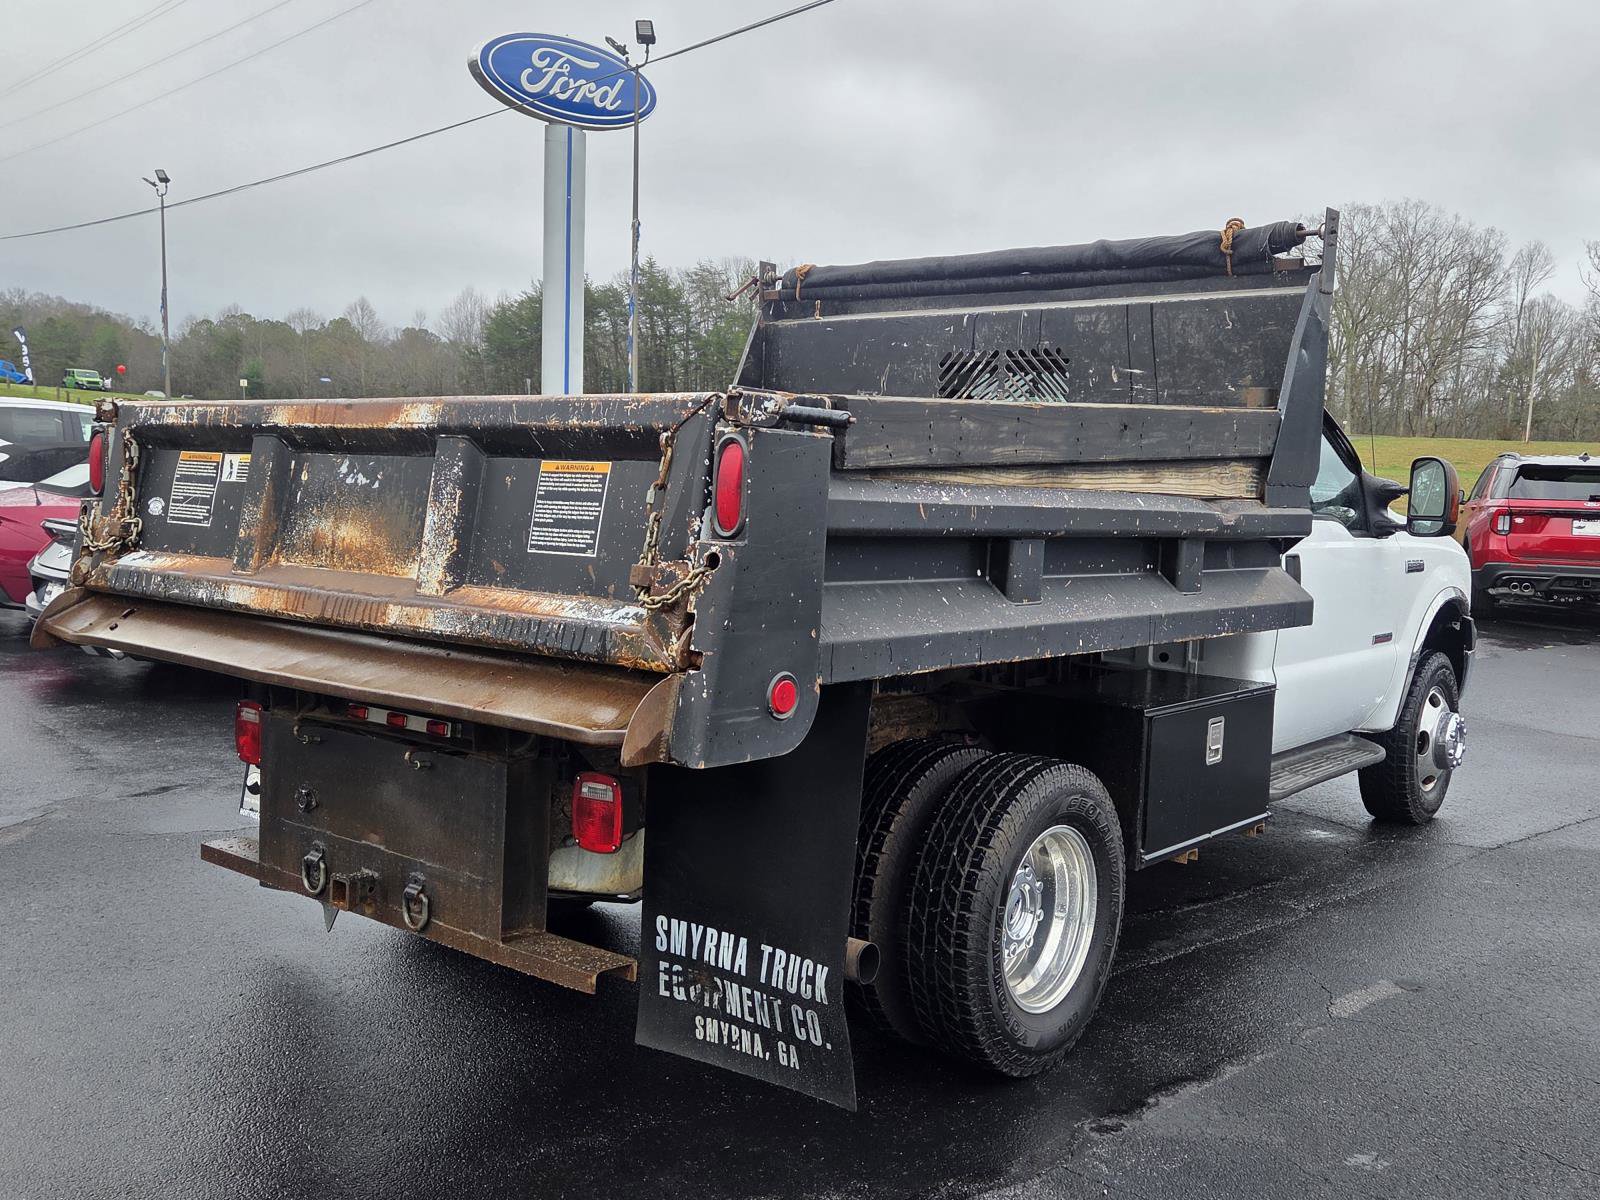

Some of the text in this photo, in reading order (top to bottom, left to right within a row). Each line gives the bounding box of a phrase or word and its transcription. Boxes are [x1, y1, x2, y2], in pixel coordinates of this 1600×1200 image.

[520, 47, 625, 111] Ford
[655, 914, 829, 1005] SMYRNA TRUCK
[694, 1015, 800, 1070] SMYRNA, GA
[790, 1003, 832, 1050] CO.
